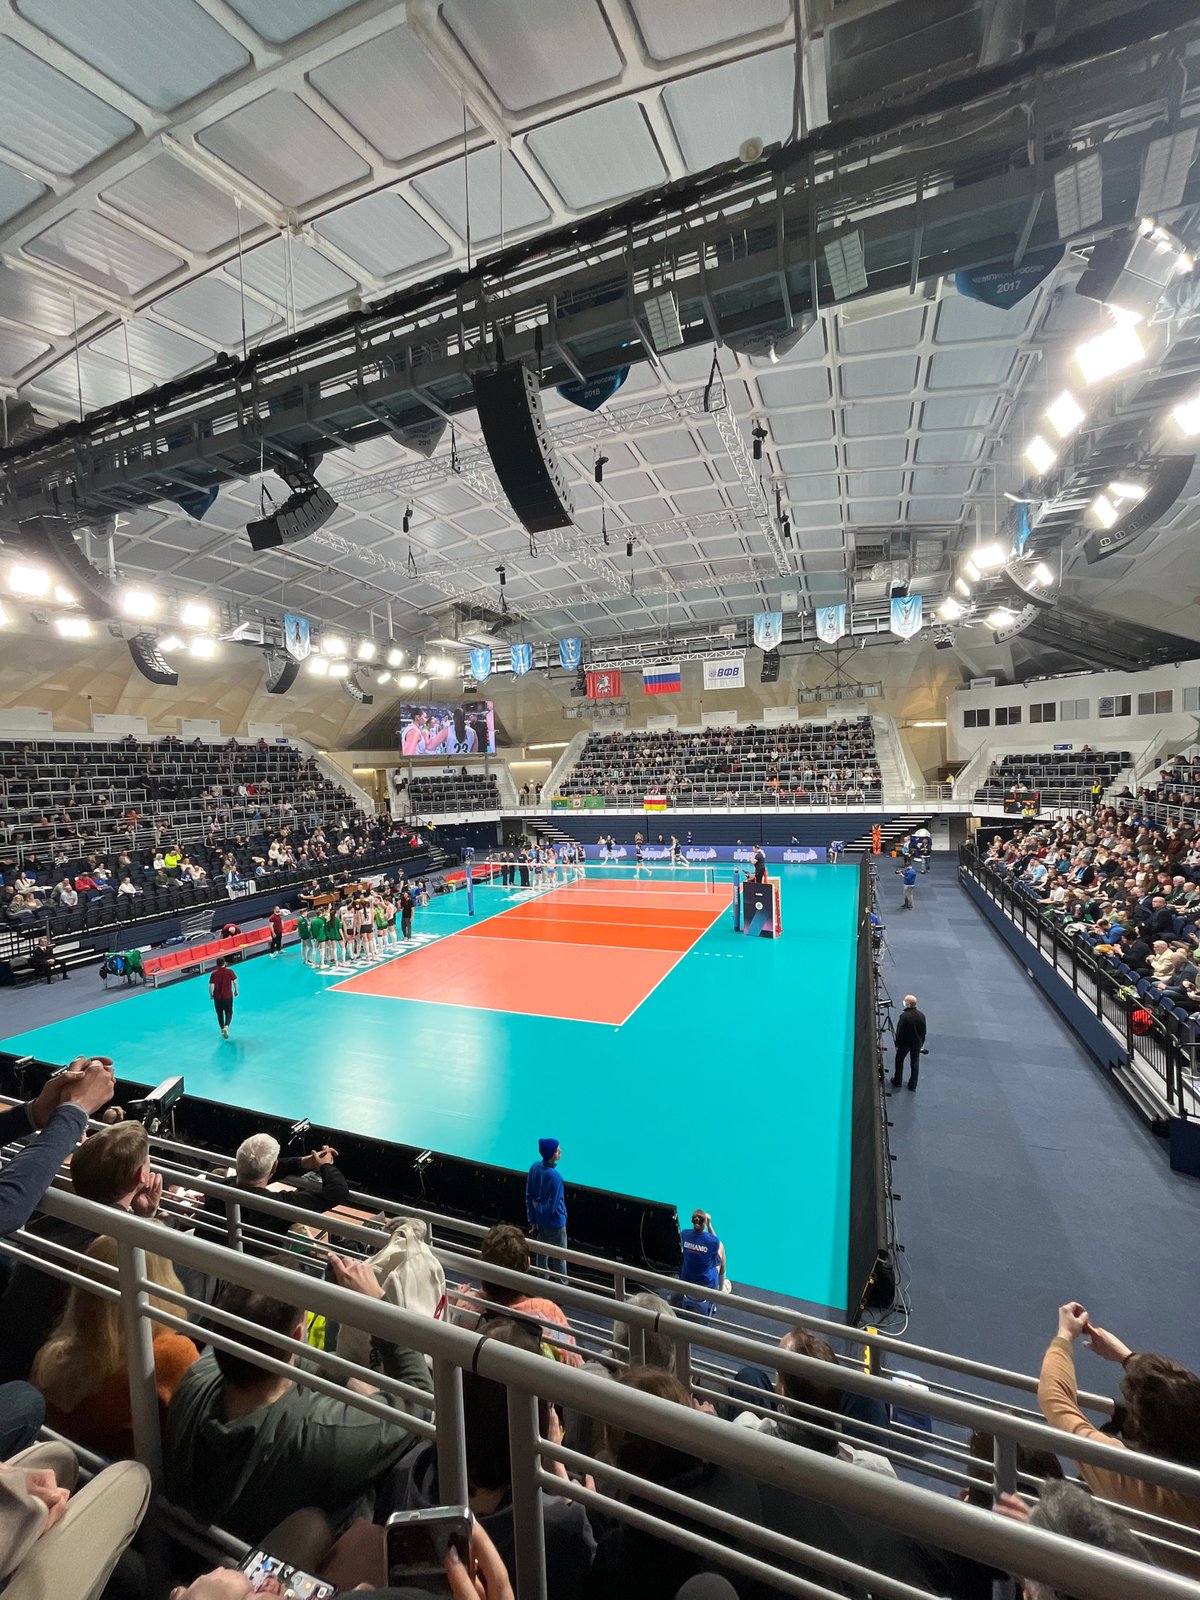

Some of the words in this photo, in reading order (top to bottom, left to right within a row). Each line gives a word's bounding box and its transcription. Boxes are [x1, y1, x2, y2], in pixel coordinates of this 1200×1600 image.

[996, 280, 1022, 294] 2017
[584, 387, 602, 399] 2018
[717, 666, 740, 677] ВФВ
[454, 742, 469, 754] 23
[683, 1241, 709, 1253] ДИНАМО
